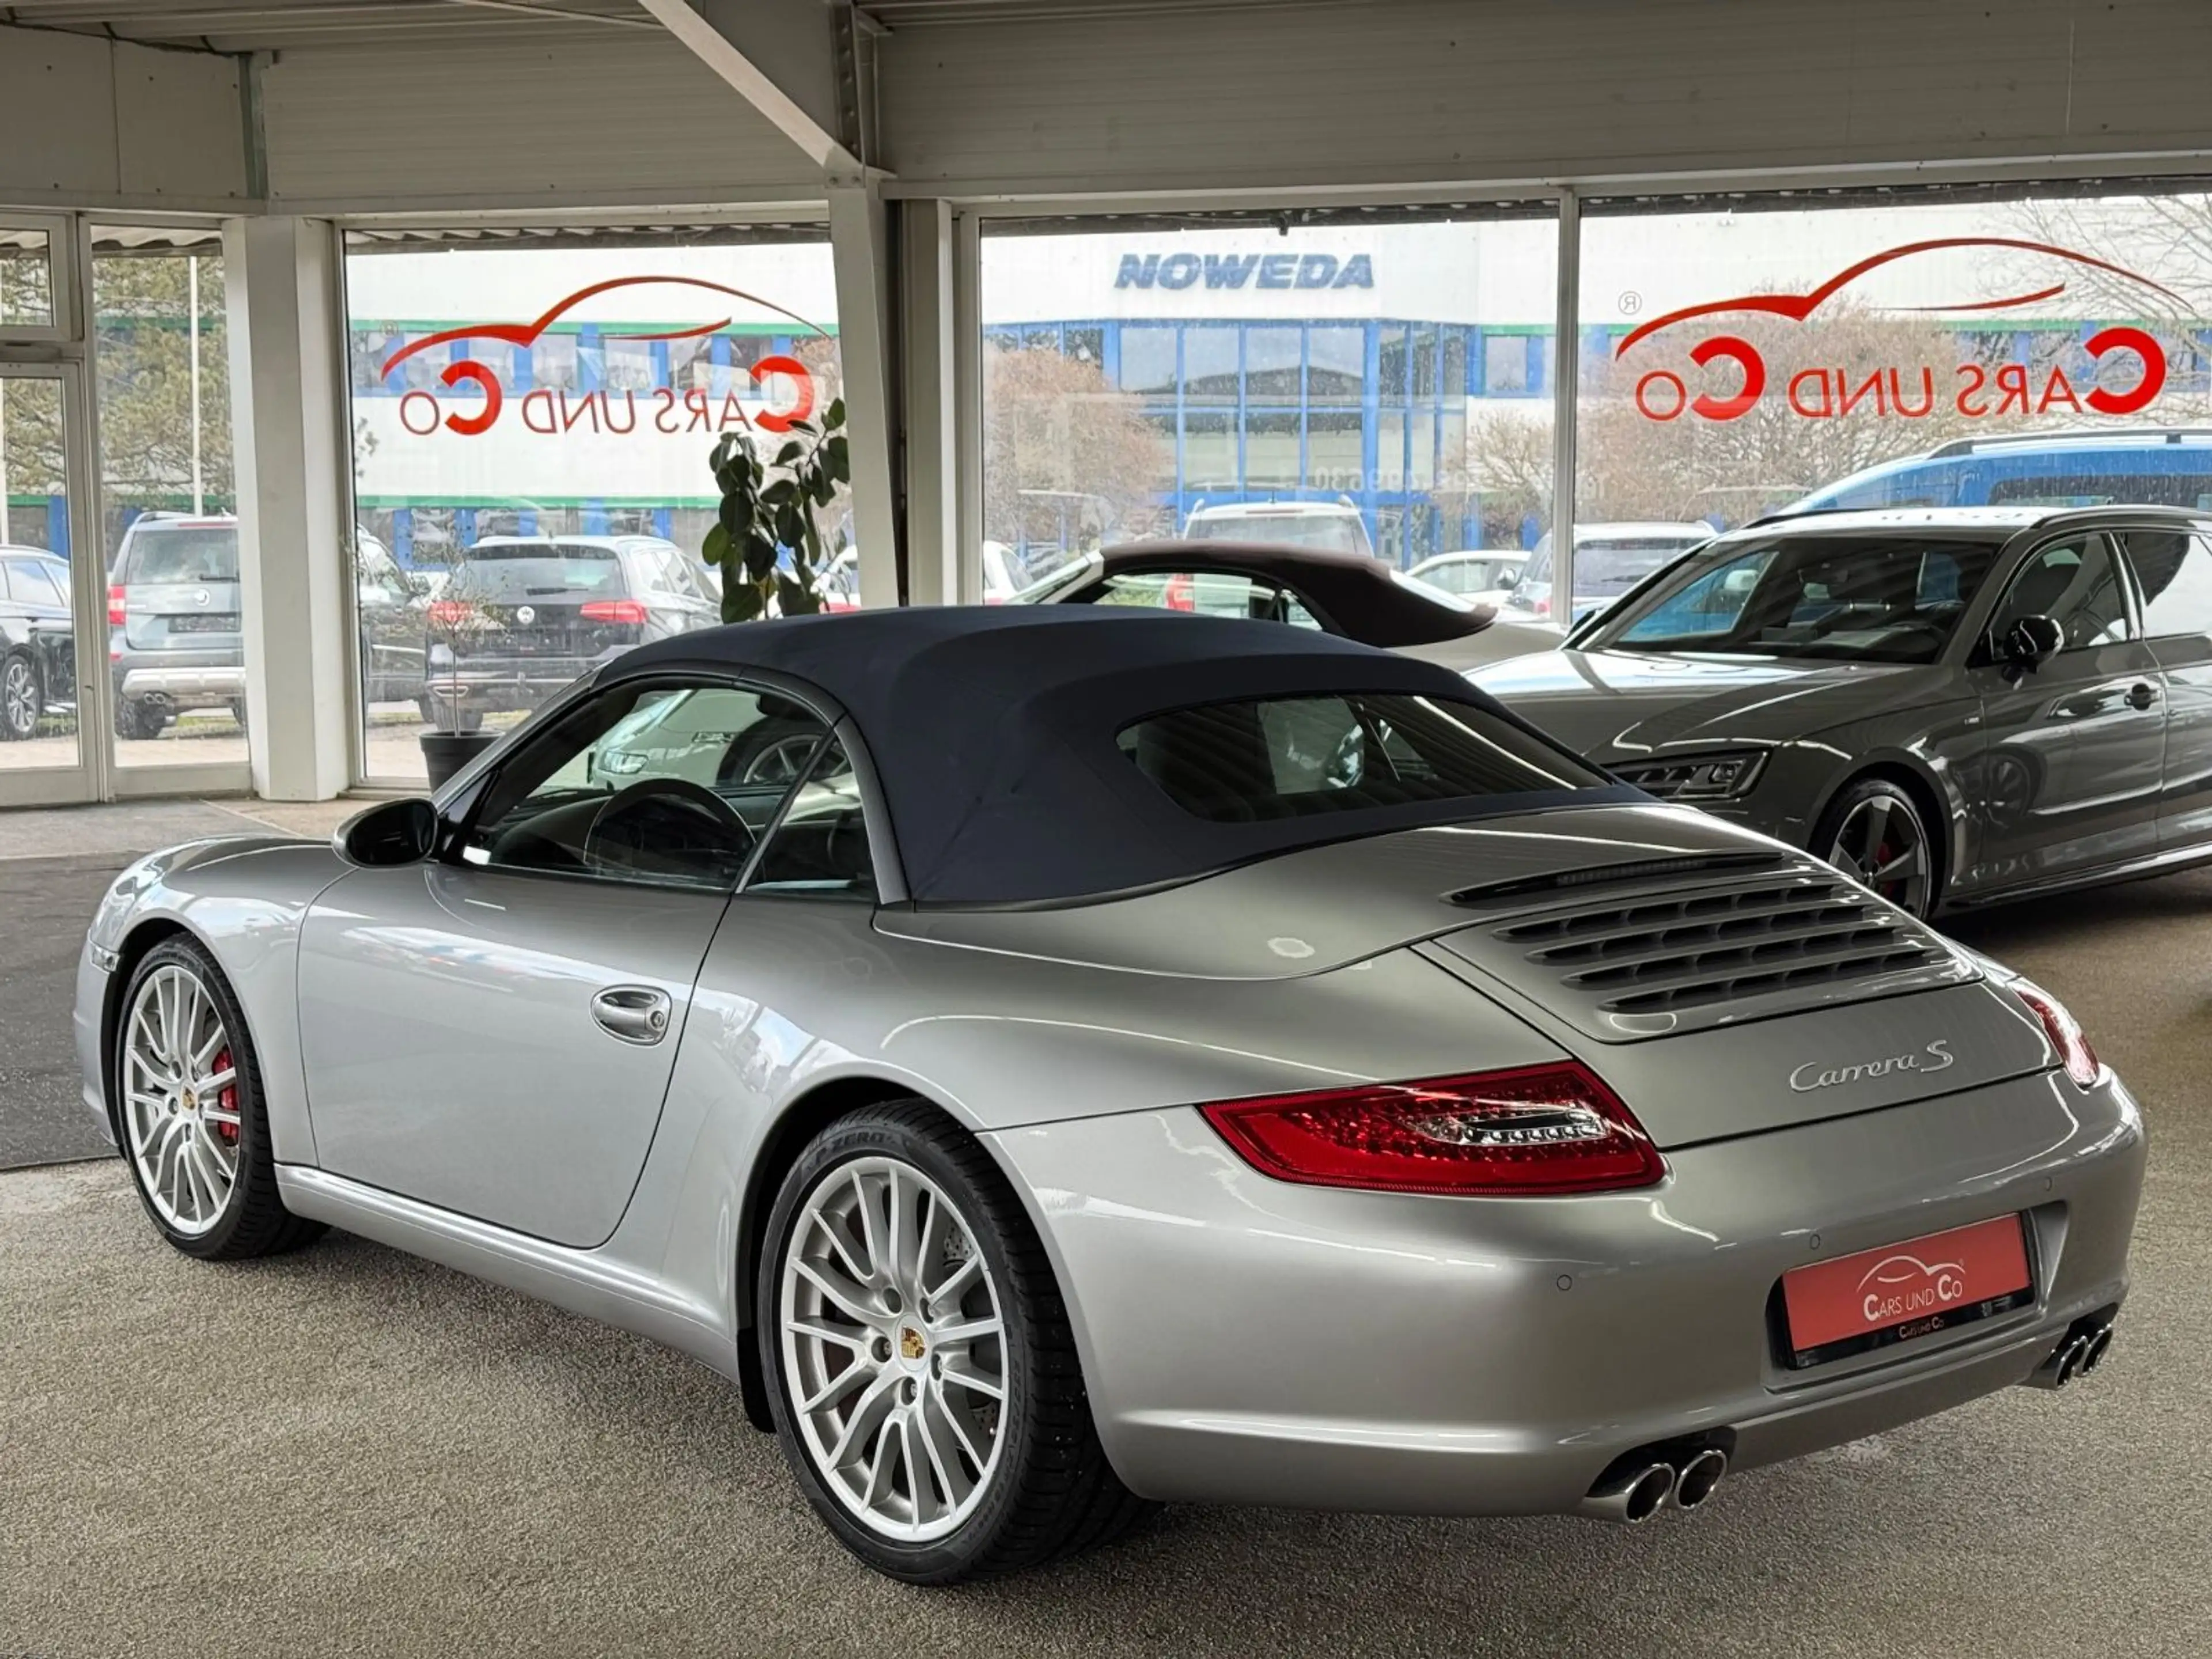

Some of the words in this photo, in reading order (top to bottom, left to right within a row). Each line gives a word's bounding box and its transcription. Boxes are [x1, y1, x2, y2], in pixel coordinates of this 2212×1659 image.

[1113, 253, 1374, 290] NOWEDA
[1789, 1054, 1920, 1092] Carrera
[1921, 1039, 1953, 1073] S
[1863, 1293, 1902, 1321] CARS
[1906, 1288, 1935, 1312] UND
